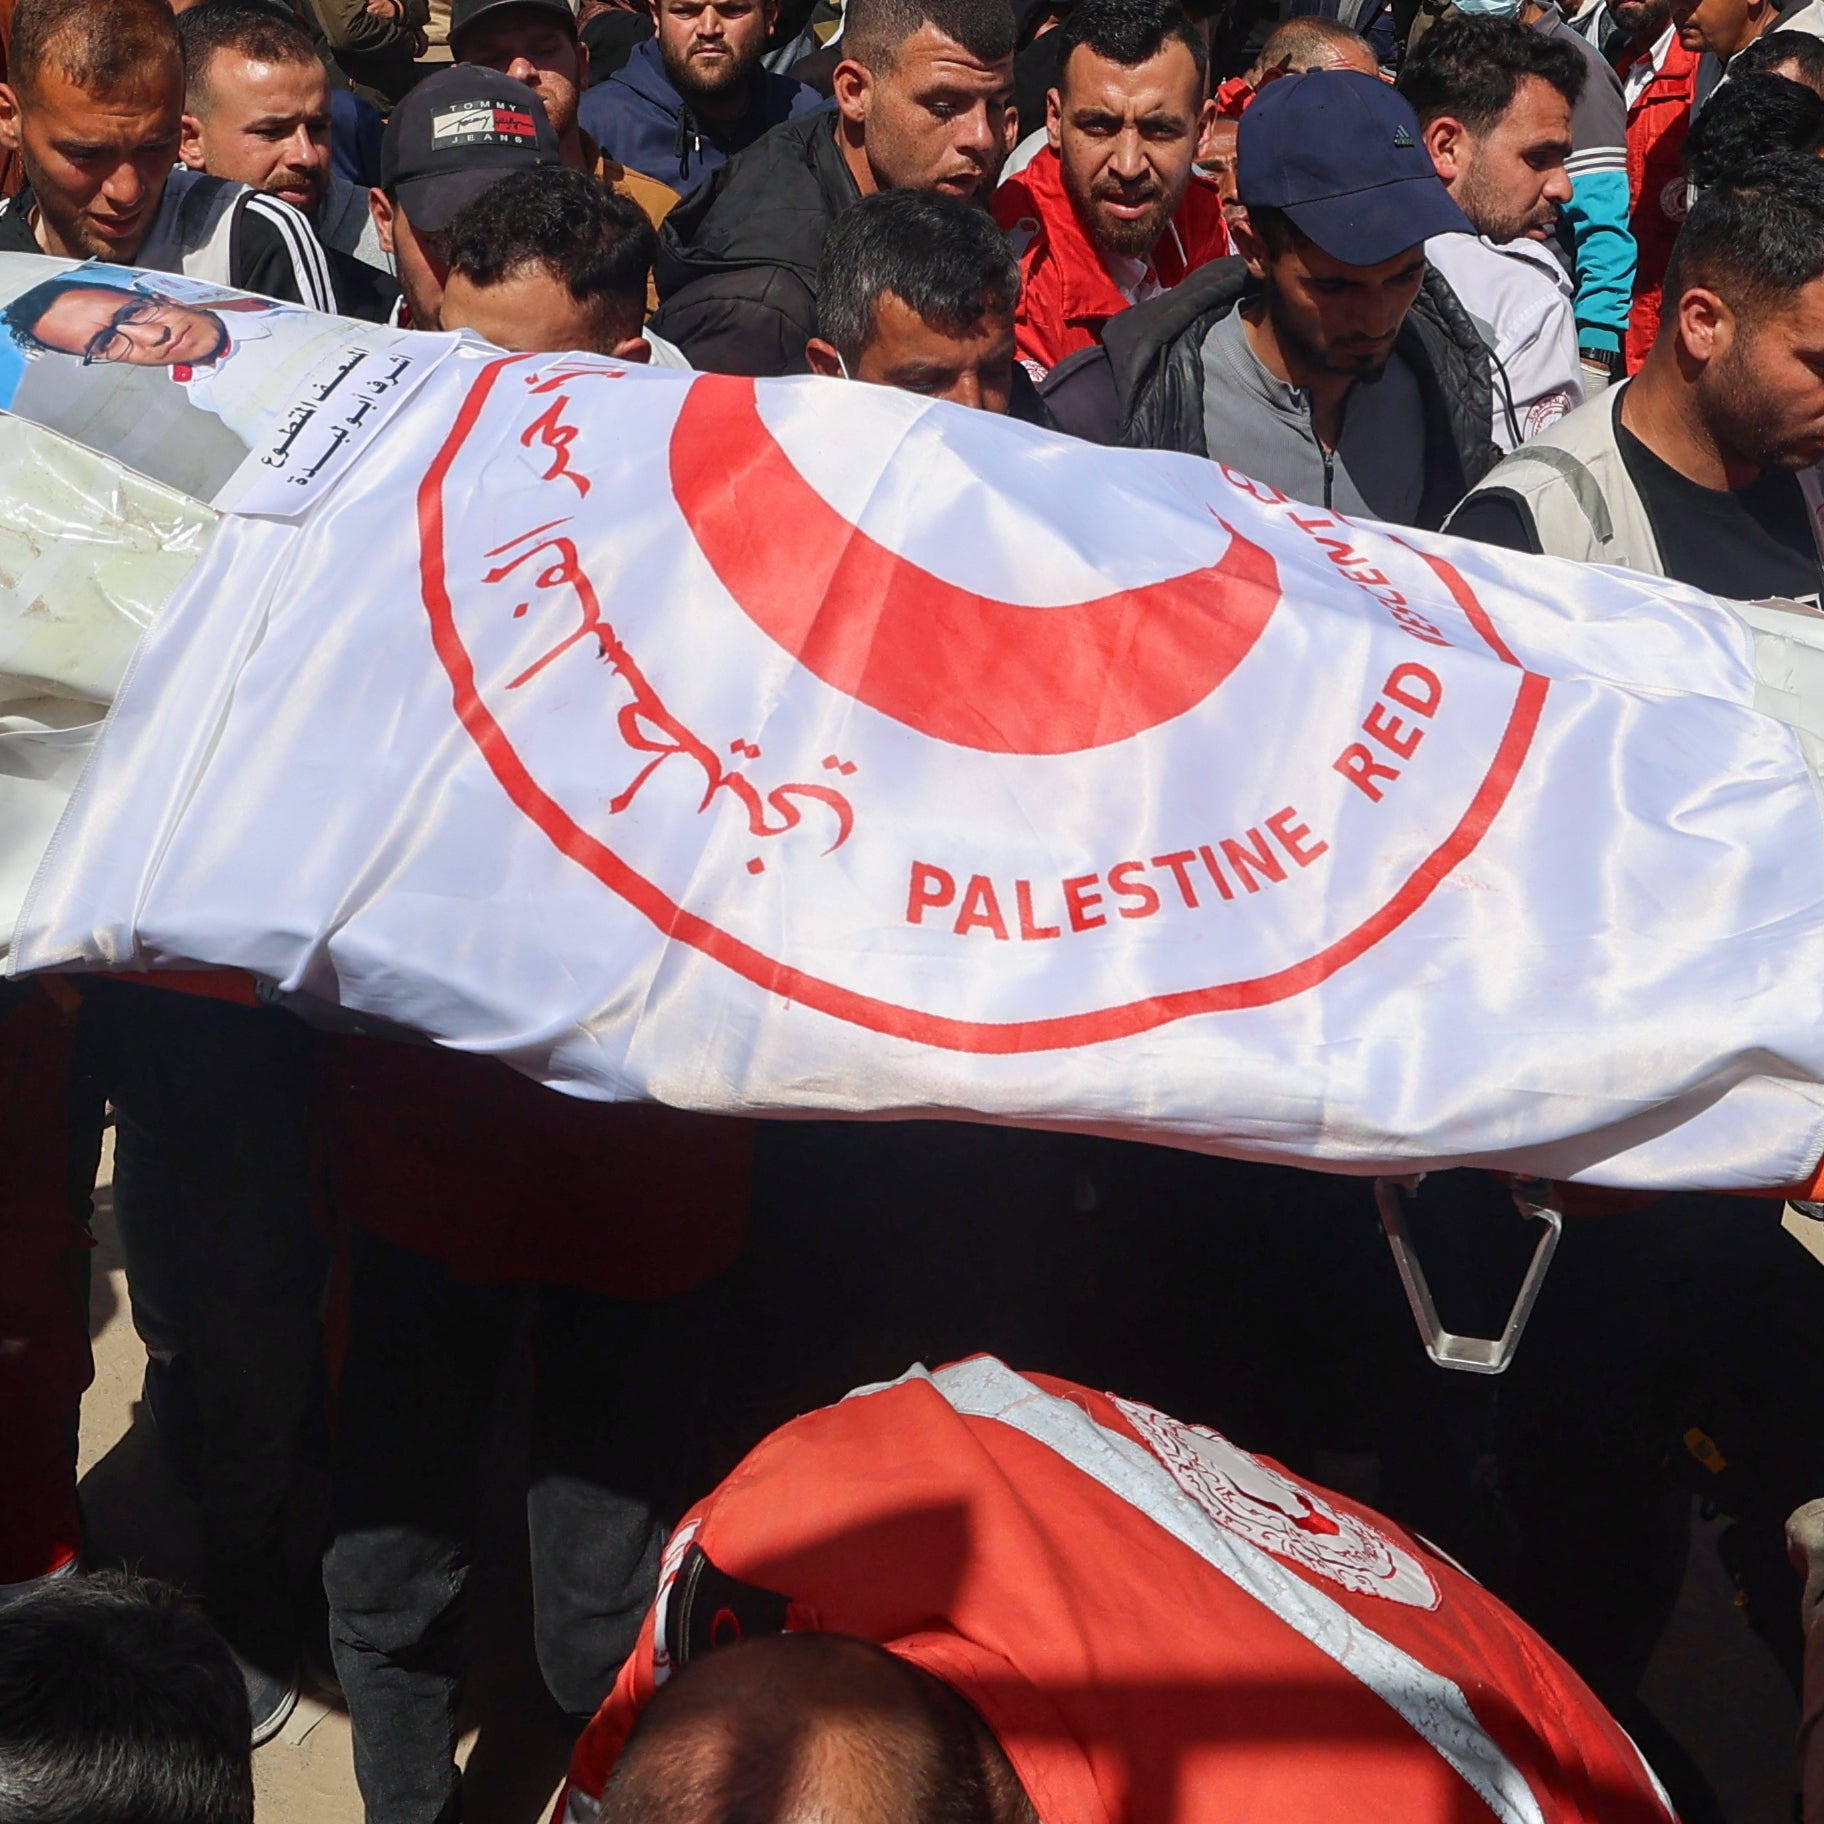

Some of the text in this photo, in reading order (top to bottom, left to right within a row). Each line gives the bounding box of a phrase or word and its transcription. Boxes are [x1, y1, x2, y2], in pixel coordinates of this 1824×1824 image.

[449, 100, 517, 112] TOMMY
[451, 134, 523, 144] JEANS
[480, 515, 858, 877] الفلسطيني
[906, 806, 1330, 941] PALESTINE
[1332, 661, 1443, 803] RED
